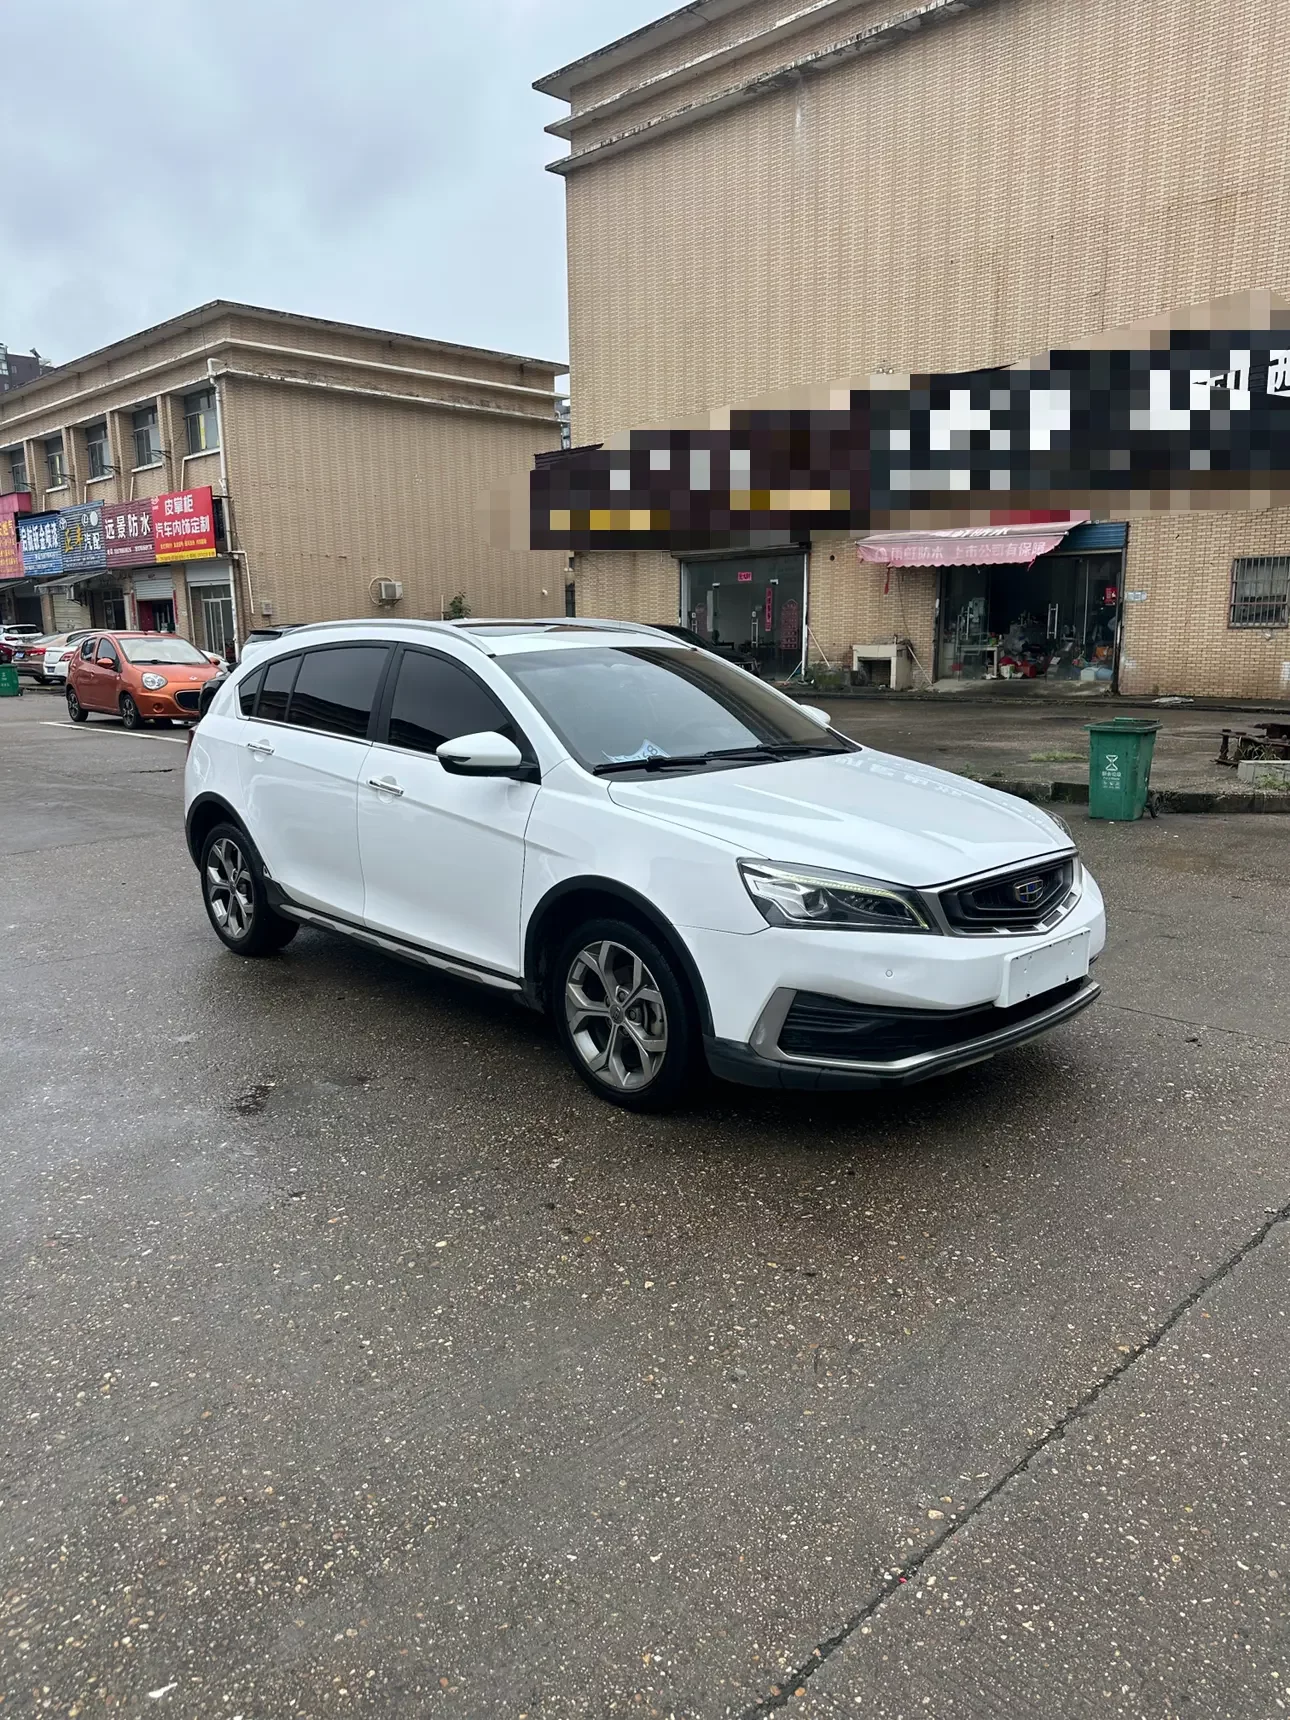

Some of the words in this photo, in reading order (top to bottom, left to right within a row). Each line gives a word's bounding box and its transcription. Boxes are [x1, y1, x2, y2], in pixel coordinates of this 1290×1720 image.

[164, 494, 194, 516] 皮掌柜
[105, 512, 151, 539] 远景防水
[155, 515, 210, 539] 汽车内饰定制
